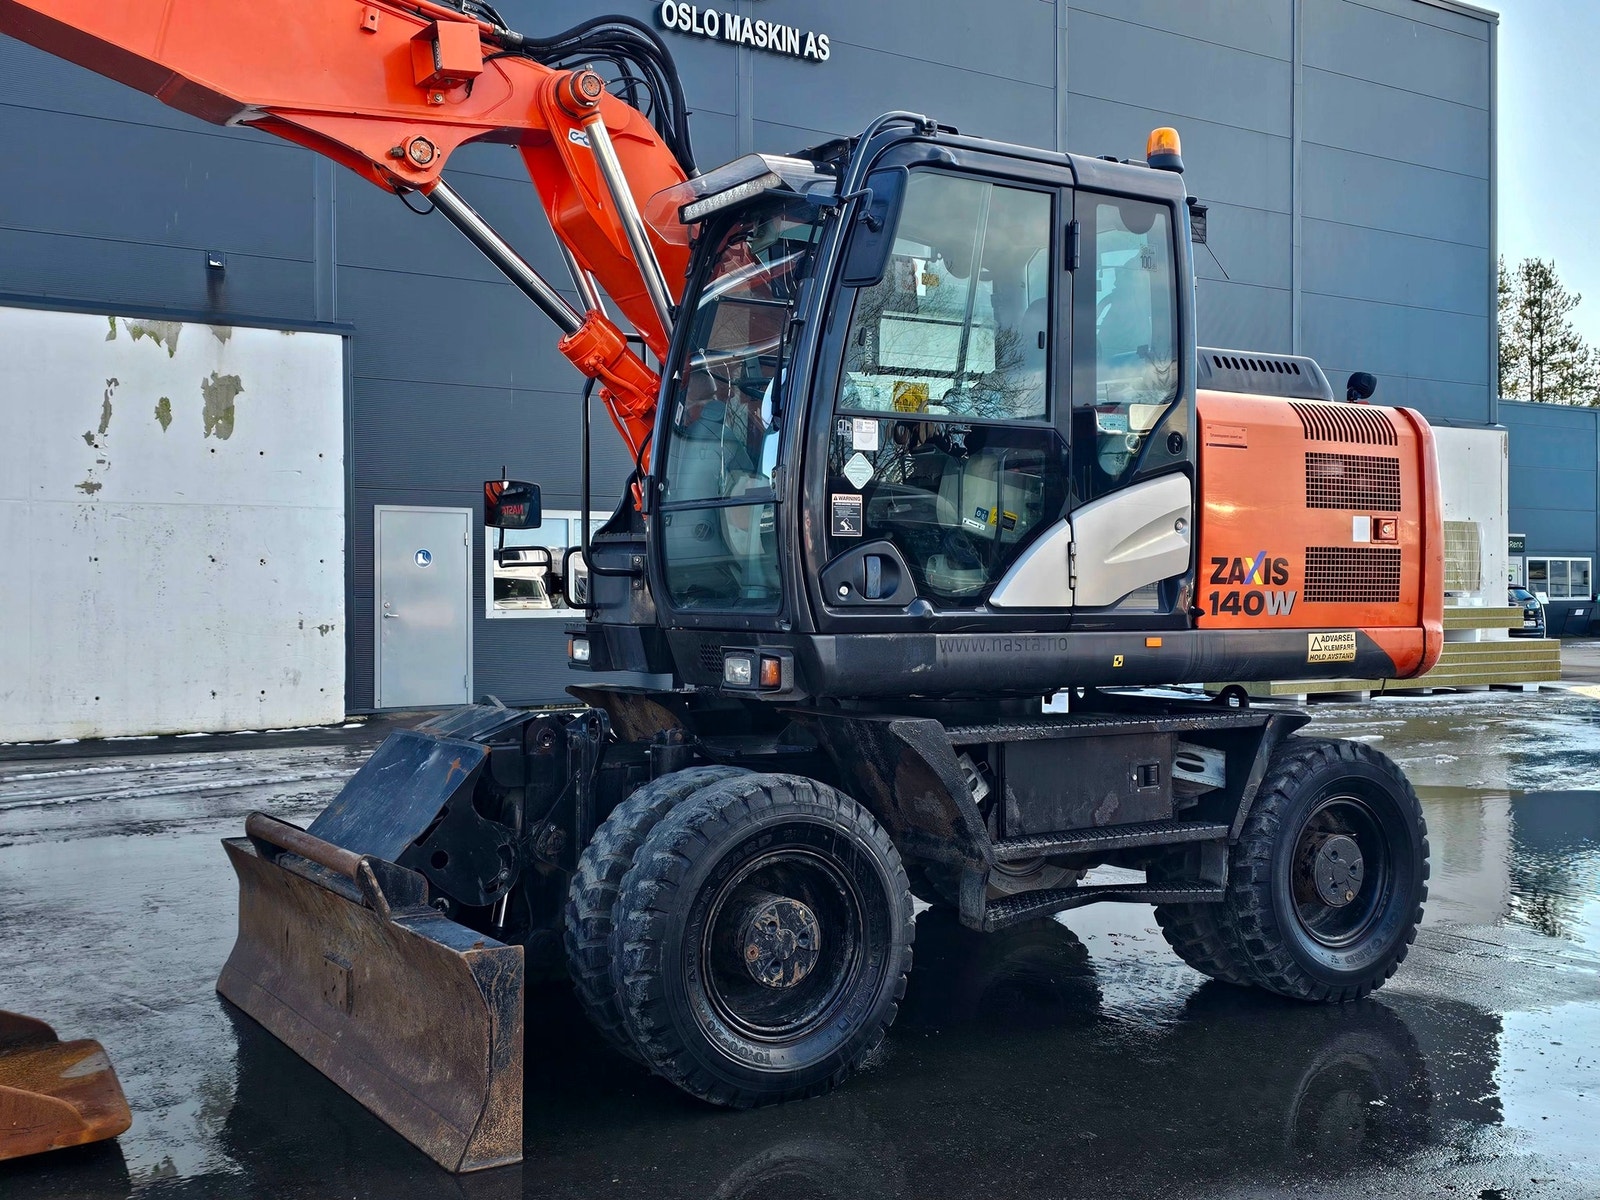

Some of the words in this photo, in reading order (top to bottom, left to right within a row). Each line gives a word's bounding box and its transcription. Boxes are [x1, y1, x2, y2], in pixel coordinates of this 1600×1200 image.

[661, 0, 719, 37] OSLO
[725, 13, 800, 55] MASKIN
[804, 31, 830, 61] AS
[1210, 551, 1289, 585] ZAXIS
[1209, 590, 1297, 616] 140W
[939, 636, 1068, 653] www.nasta.no
[1321, 634, 1354, 642] ADVARSEL
